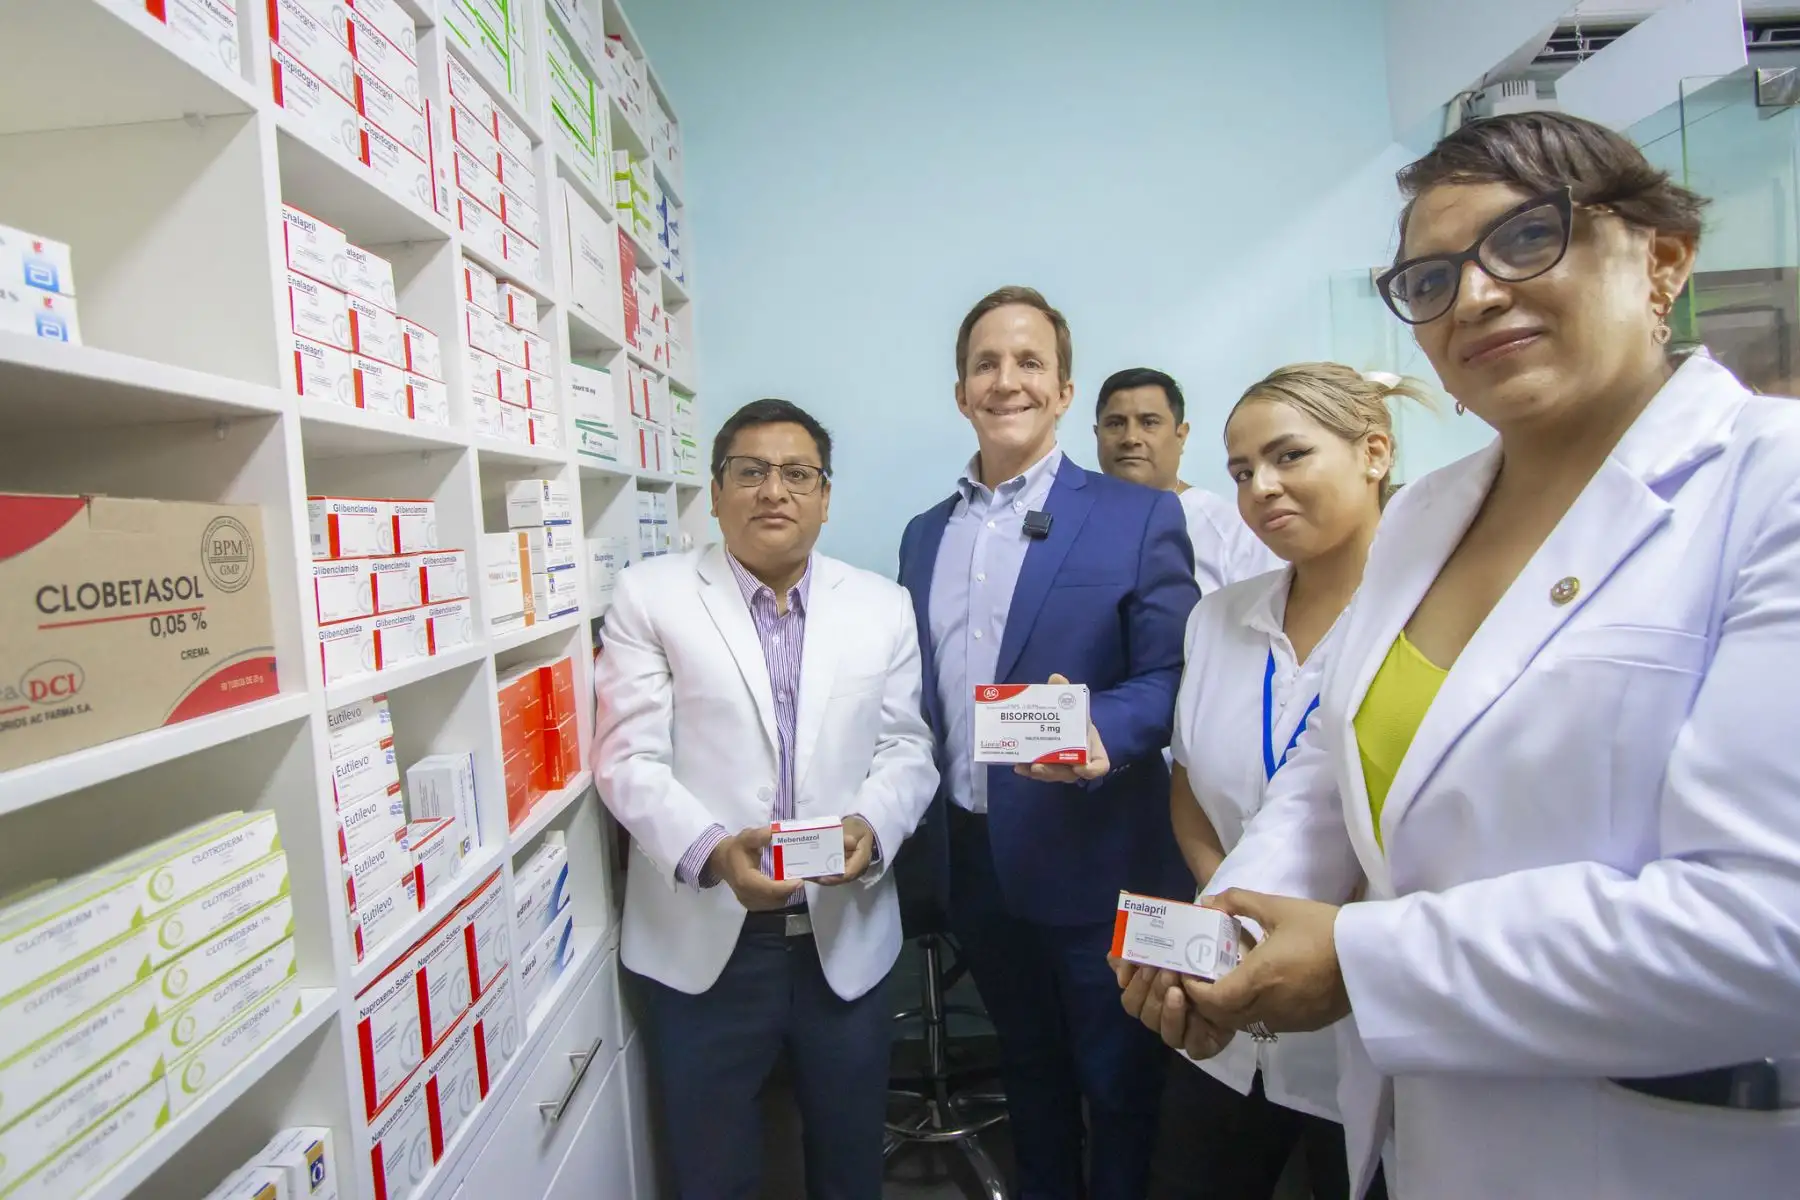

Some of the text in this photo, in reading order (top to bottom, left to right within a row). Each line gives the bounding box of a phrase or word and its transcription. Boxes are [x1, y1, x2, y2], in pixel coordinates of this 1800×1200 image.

[277, 51, 320, 92] Clopidogrel
[358, 67, 394, 102] Clopidogrel
[281, 208, 317, 233] Enalapril
[346, 248, 367, 262] alapril
[287, 274, 318, 295] Enalapril
[352, 300, 377, 318] Enalapril
[295, 340, 324, 358] Enalapril
[357, 359, 383, 376] Enalapril
[333, 503, 378, 514] Glibenclamida
[394, 505, 428, 514] Glibenclamida
[212, 540, 244, 556] BPM
[312, 563, 359, 576] Glibenclamida
[372, 561, 411, 572] Glibenclamida
[422, 555, 457, 566] Glibenclamida
[36, 575, 204, 615] CLOBETASOL
[428, 603, 463, 617] Glibenclamida
[150, 611, 208, 638] 0,05 %
[375, 613, 416, 628] Glibenclamida
[318, 623, 363, 640] Glibenclamida
[181, 646, 210, 660] CREMA
[29, 672, 77, 703] DCI
[30, 713, 43, 725] AC
[45, 706, 75, 721] FARMA
[328, 707, 362, 728] Eutilevo
[1000, 712, 1060, 721] BISOPROLOL
[1040, 724, 1060, 734] 5 mg
[336, 754, 370, 778] Eutilevo
[344, 802, 378, 828] Eutilevo
[777, 834, 820, 844] Mebendazol
[191, 834, 244, 865] CLOTRIDERM
[354, 850, 386, 877] Eutilevo
[201, 876, 253, 910] CLOTRIDERM
[362, 896, 393, 926] Eutilevo
[1124, 899, 1167, 916] Enalapril
[205, 921, 259, 957] CLOTRIDERM
[213, 964, 263, 1002] CLOTRIDERM
[359, 986, 394, 1019] Naproxeno
[221, 1005, 271, 1047] CLOTRIDERM
[372, 1104, 404, 1145] Naproxeno
